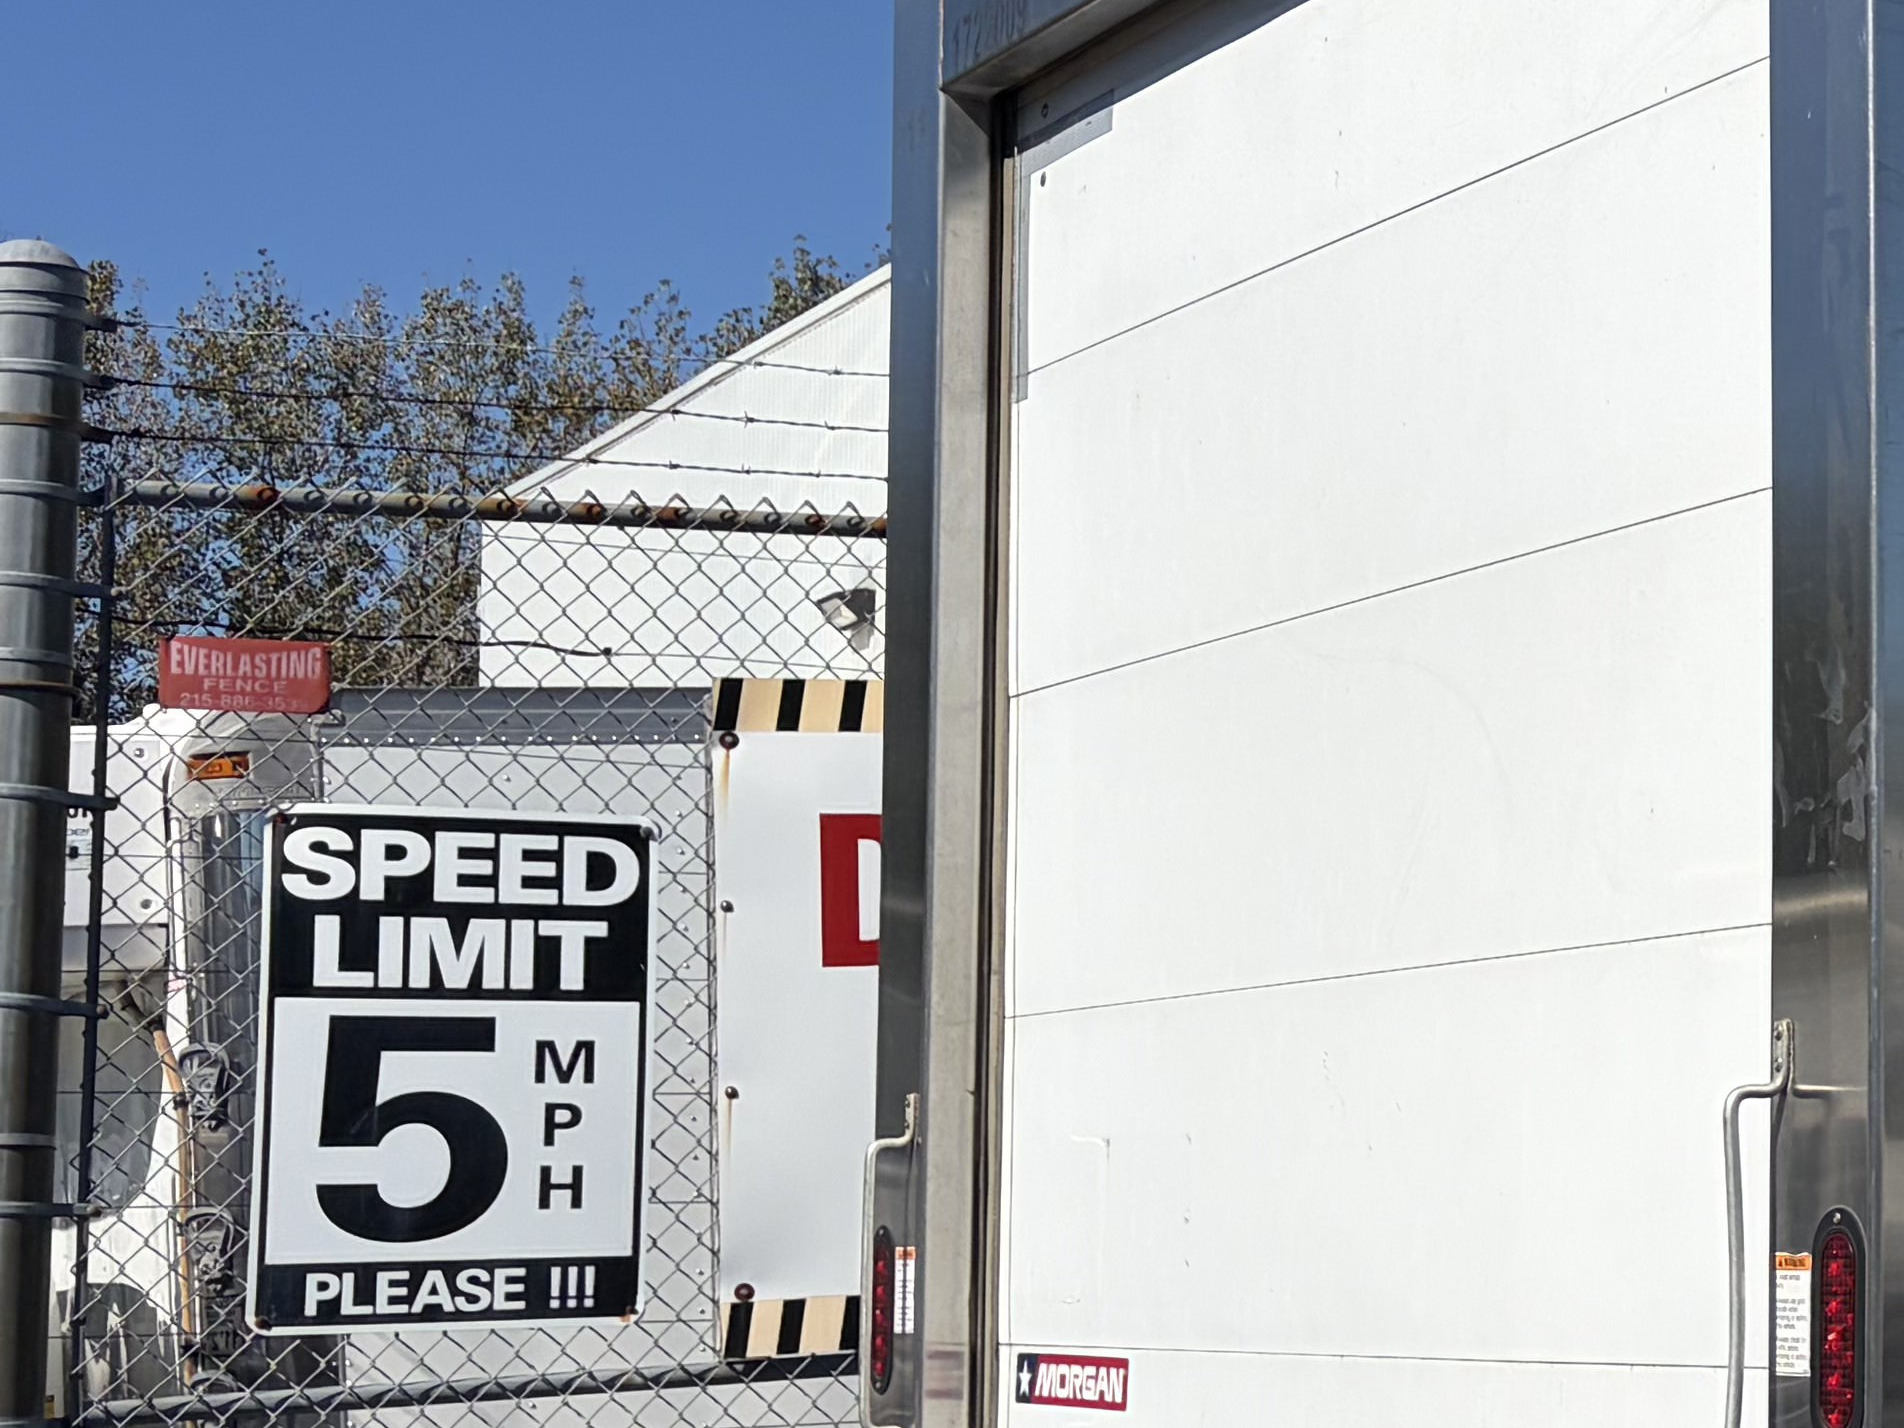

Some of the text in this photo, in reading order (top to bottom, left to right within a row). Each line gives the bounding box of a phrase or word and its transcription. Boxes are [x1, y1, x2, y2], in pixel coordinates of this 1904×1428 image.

[170, 641, 321, 679] EVERLASTING
[179, 692, 310, 712] 215-886-35
[203, 678, 288, 693] FENCE
[282, 827, 641, 907] SPEED
[312, 915, 609, 991] LIMIT
[315, 1015, 509, 1243] 5
[304, 1268, 526, 1317] PLEASE
[1034, 1362, 1125, 1404] MORGAN
